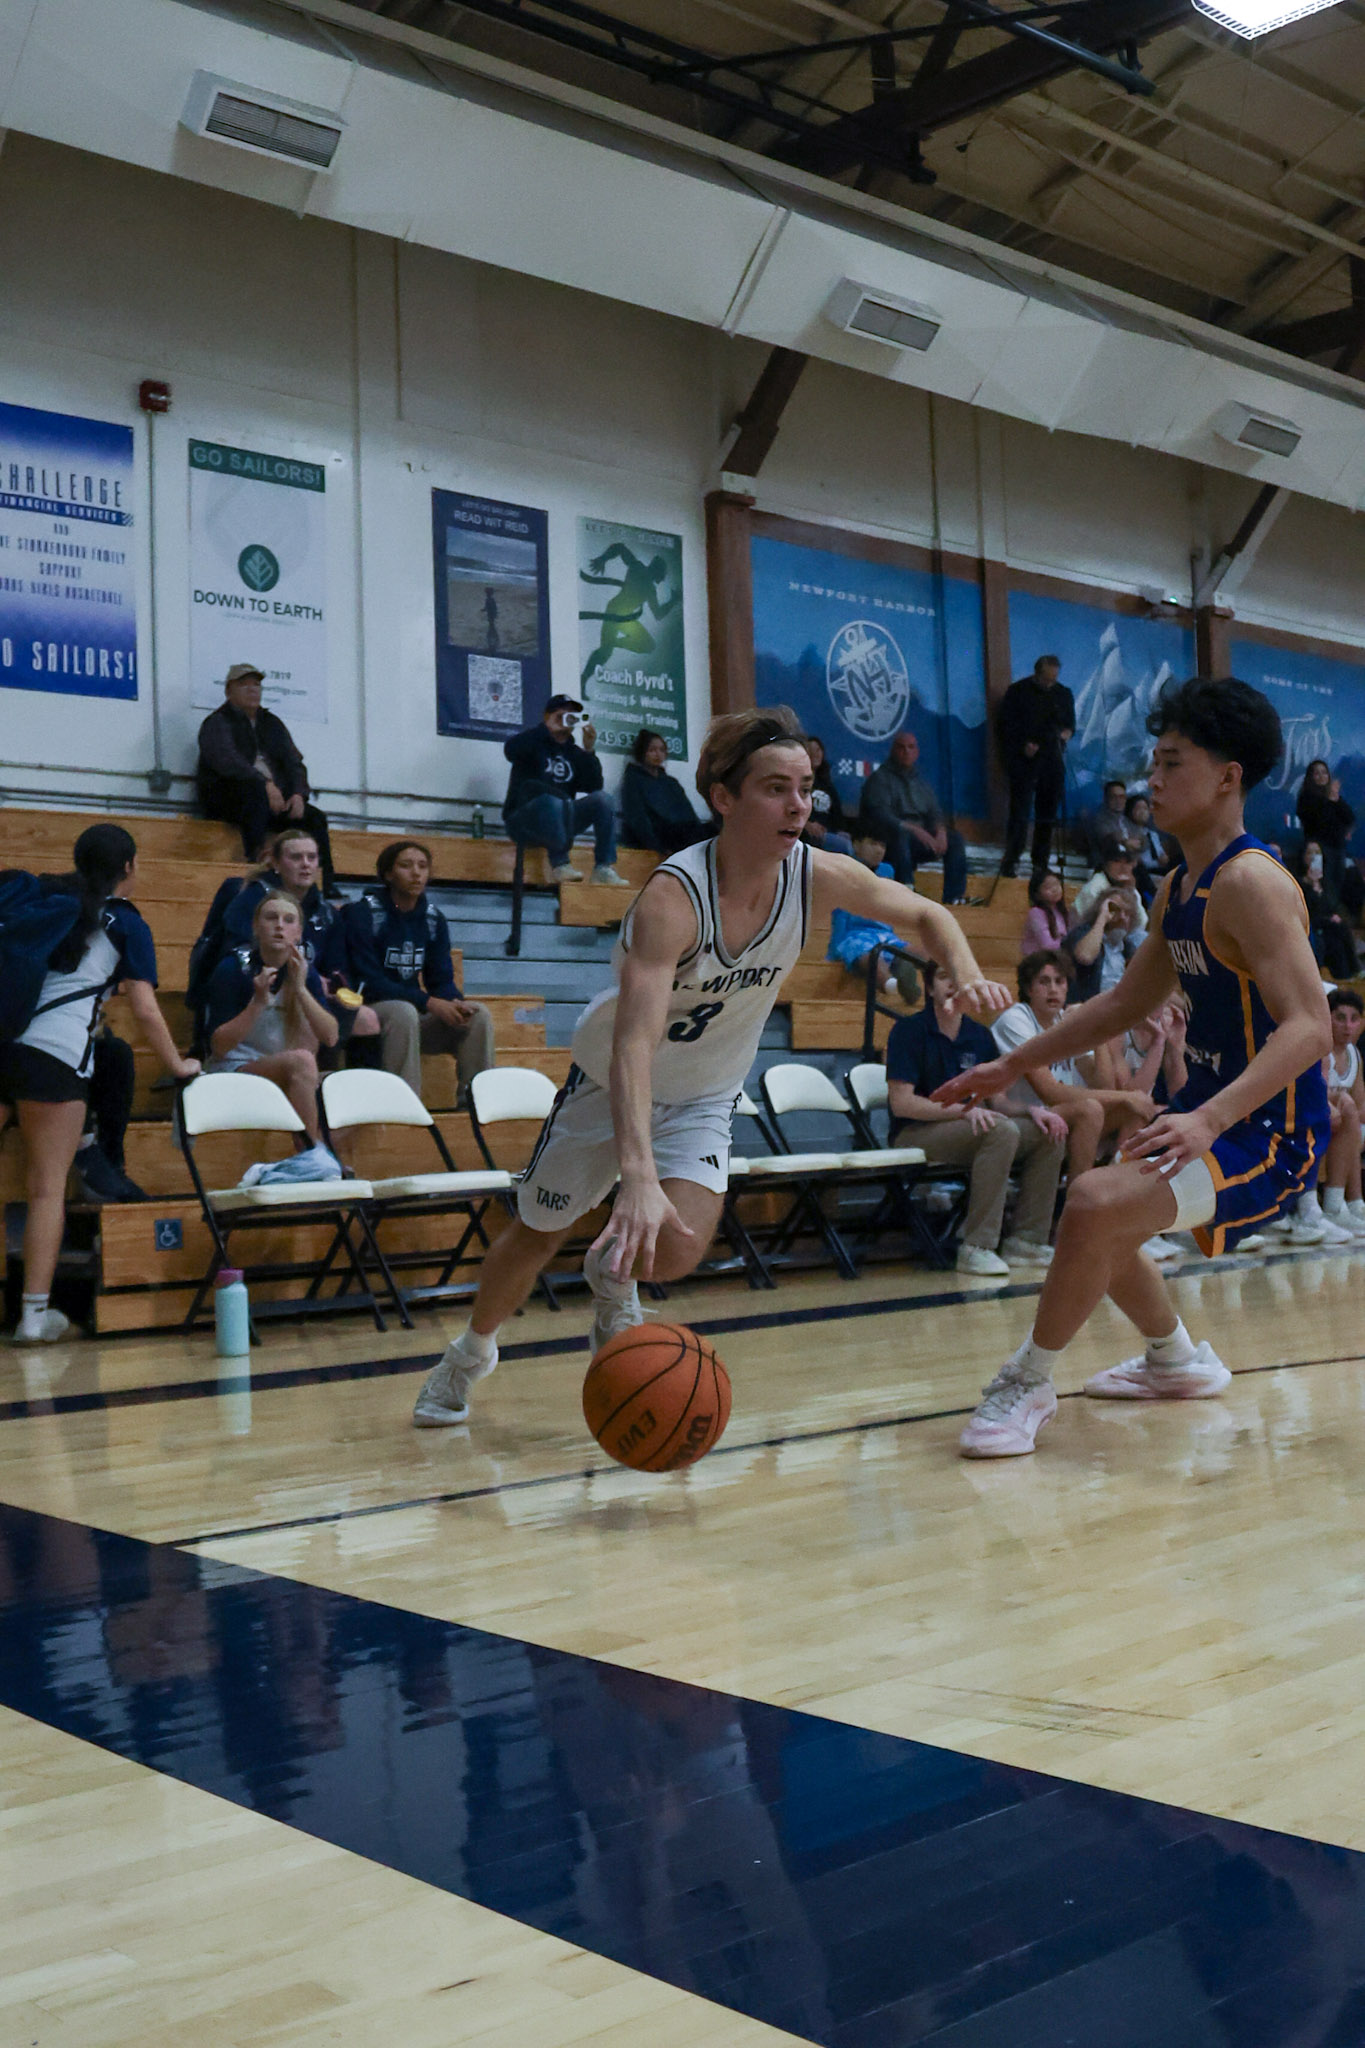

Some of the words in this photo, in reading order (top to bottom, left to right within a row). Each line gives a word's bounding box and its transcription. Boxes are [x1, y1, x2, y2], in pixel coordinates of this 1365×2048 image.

[193, 447, 222, 466] GO
[229, 453, 320, 485] SAILORS!
[0, 462, 122, 508] HALLENGE
[64, 503, 118, 522] SERVICES
[454, 510, 482, 524] READ
[193, 590, 245, 609] DOWN
[249, 598, 269, 613] TO
[273, 602, 323, 621] EARTH
[788, 581, 868, 605] NEWPORT
[872, 598, 936, 617] HARBOR
[2, 637, 12, 667] O
[32, 641, 134, 680] SAILORS!
[594, 664, 632, 686] Coach
[672, 966, 783, 994] WPORT
[536, 1186, 571, 1211] TARS
